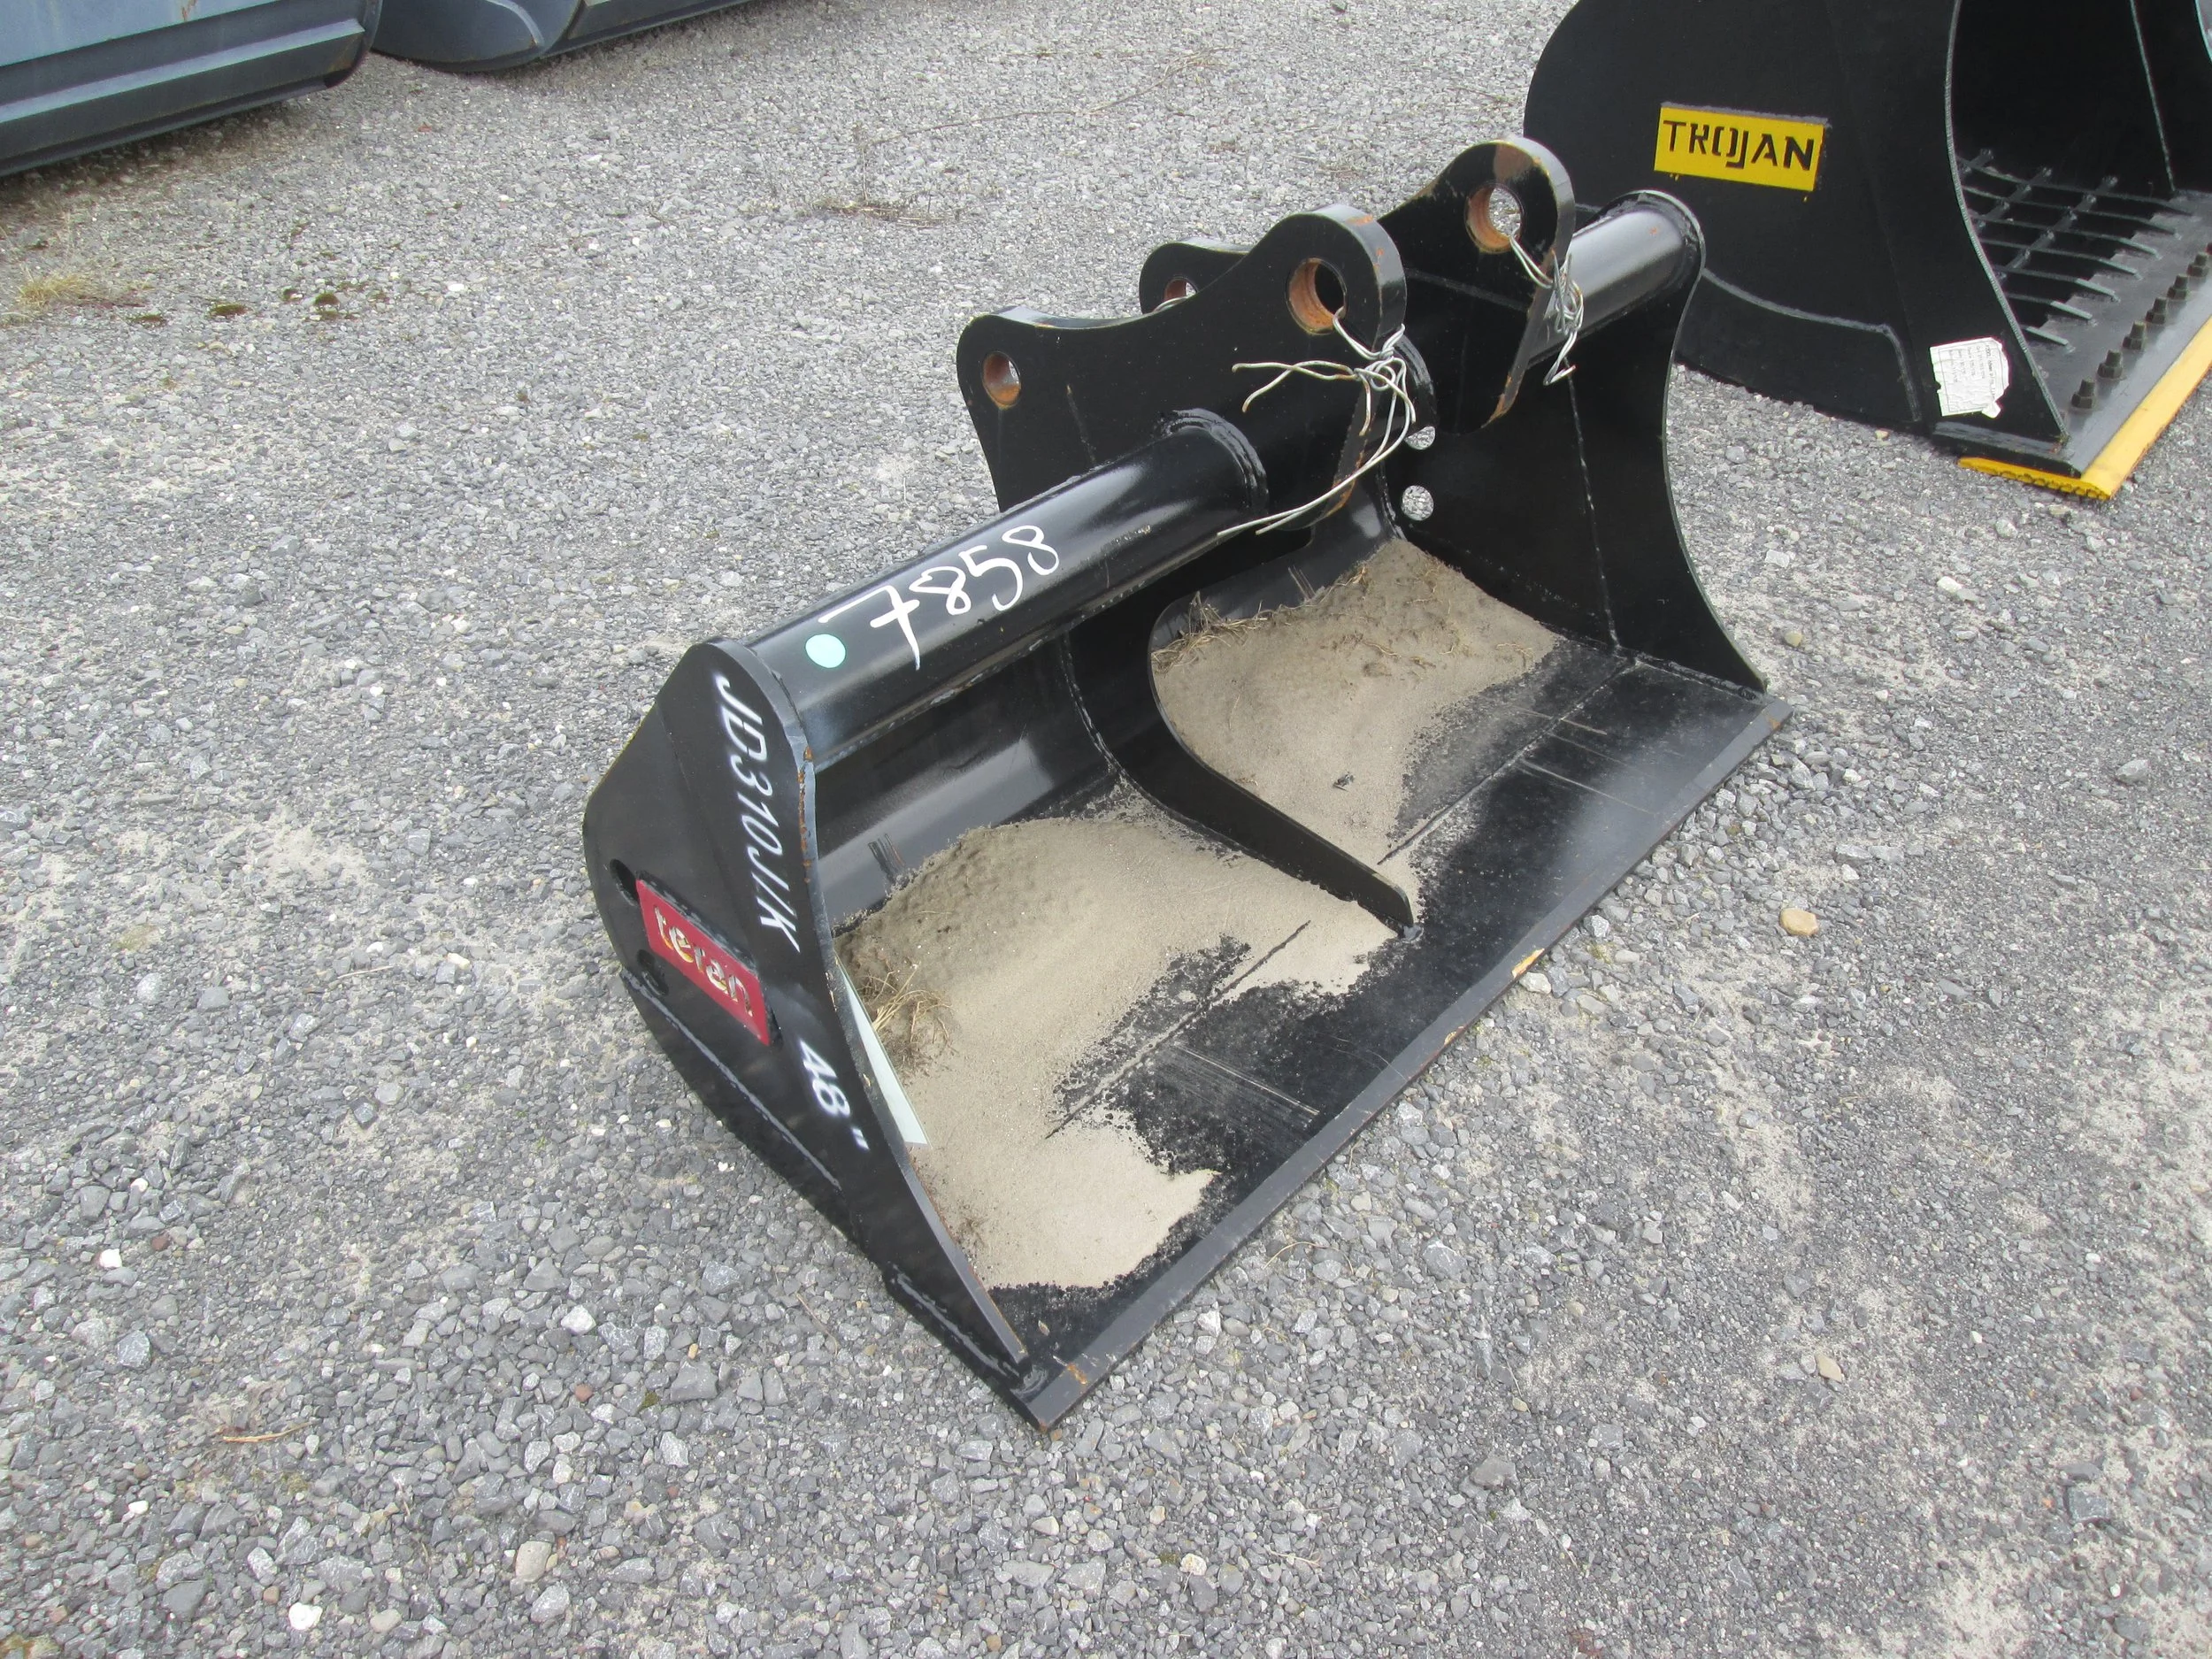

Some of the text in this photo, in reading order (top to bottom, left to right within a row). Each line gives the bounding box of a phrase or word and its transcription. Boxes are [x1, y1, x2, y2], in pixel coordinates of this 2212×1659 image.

[1663, 119, 1815, 171] TROJAN
[818, 525, 1060, 671] 7858
[714, 673, 801, 953] JD310J/K
